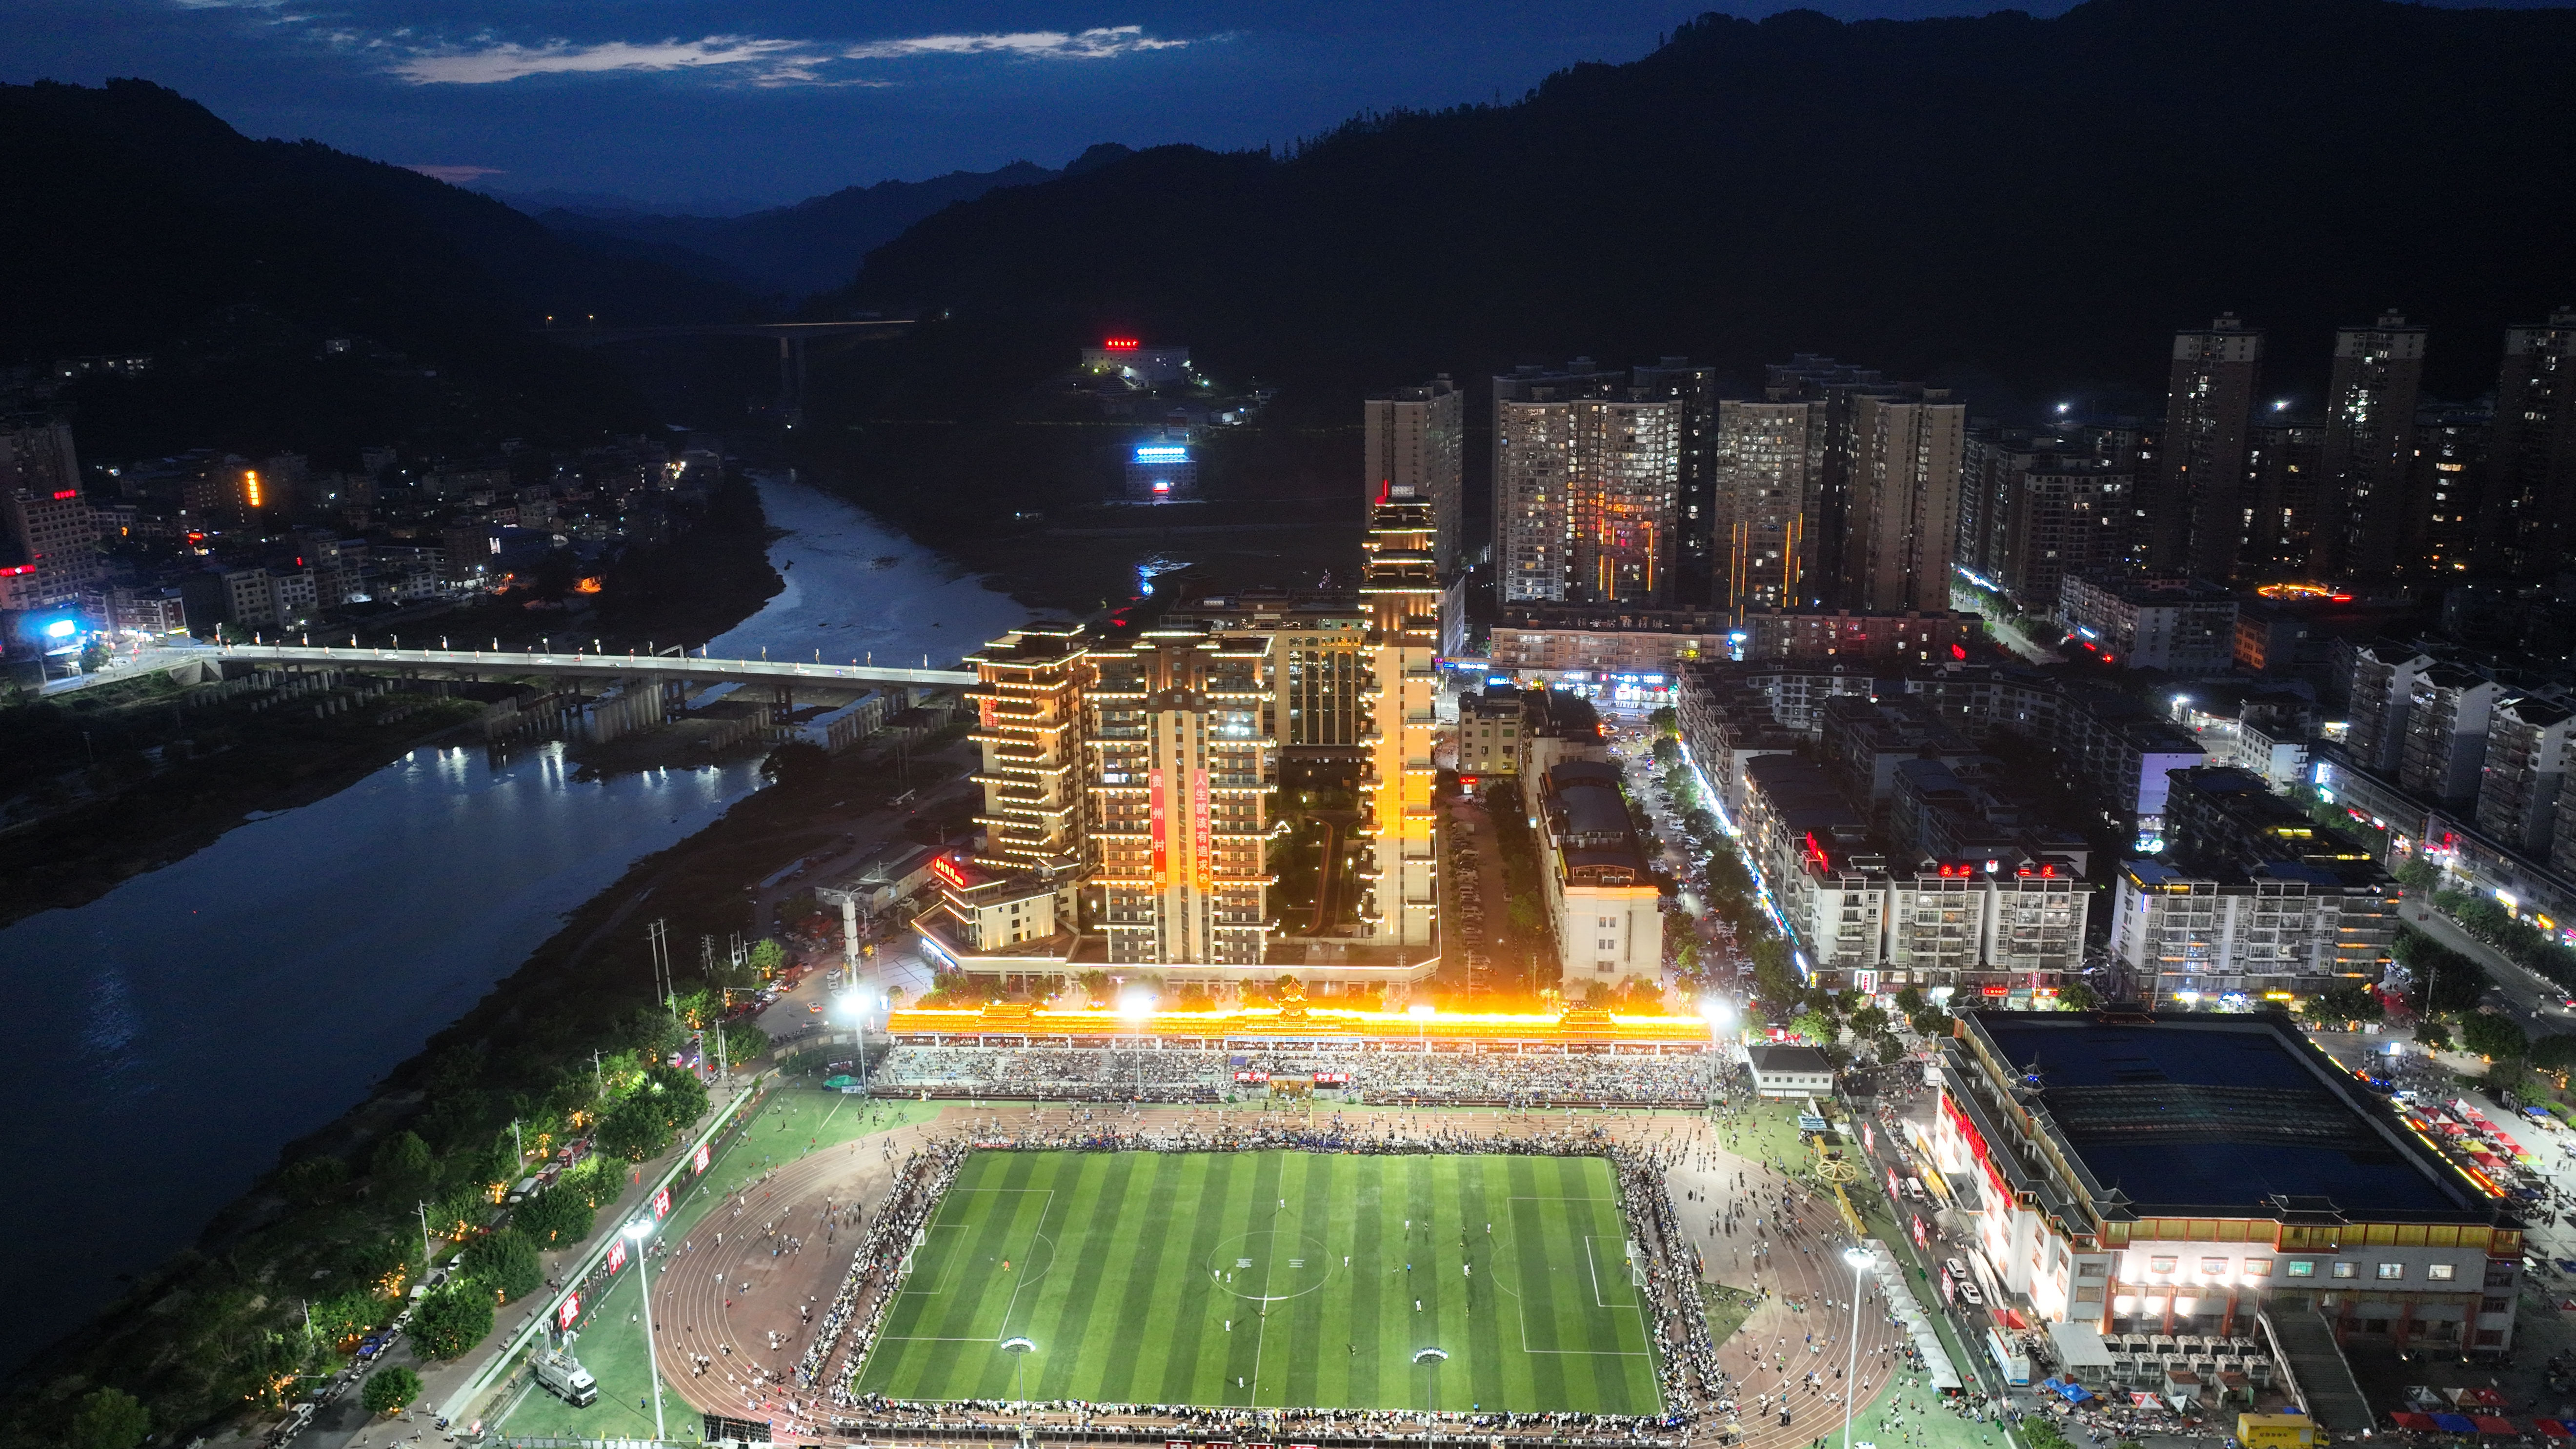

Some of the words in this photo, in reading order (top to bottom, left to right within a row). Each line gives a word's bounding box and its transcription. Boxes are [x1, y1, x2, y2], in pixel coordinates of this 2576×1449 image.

[1152, 775, 1167, 884] 贵州村超
[1195, 774, 1209, 871] 人生就该有追求
[562, 1296, 579, 1327] 贵
[611, 1241, 625, 1271] 州
[655, 1189, 669, 1217] 村
[696, 1146, 709, 1173] 超
[1913, 1218, 1923, 1247] 村
[1942, 1271, 1952, 1305] 超
